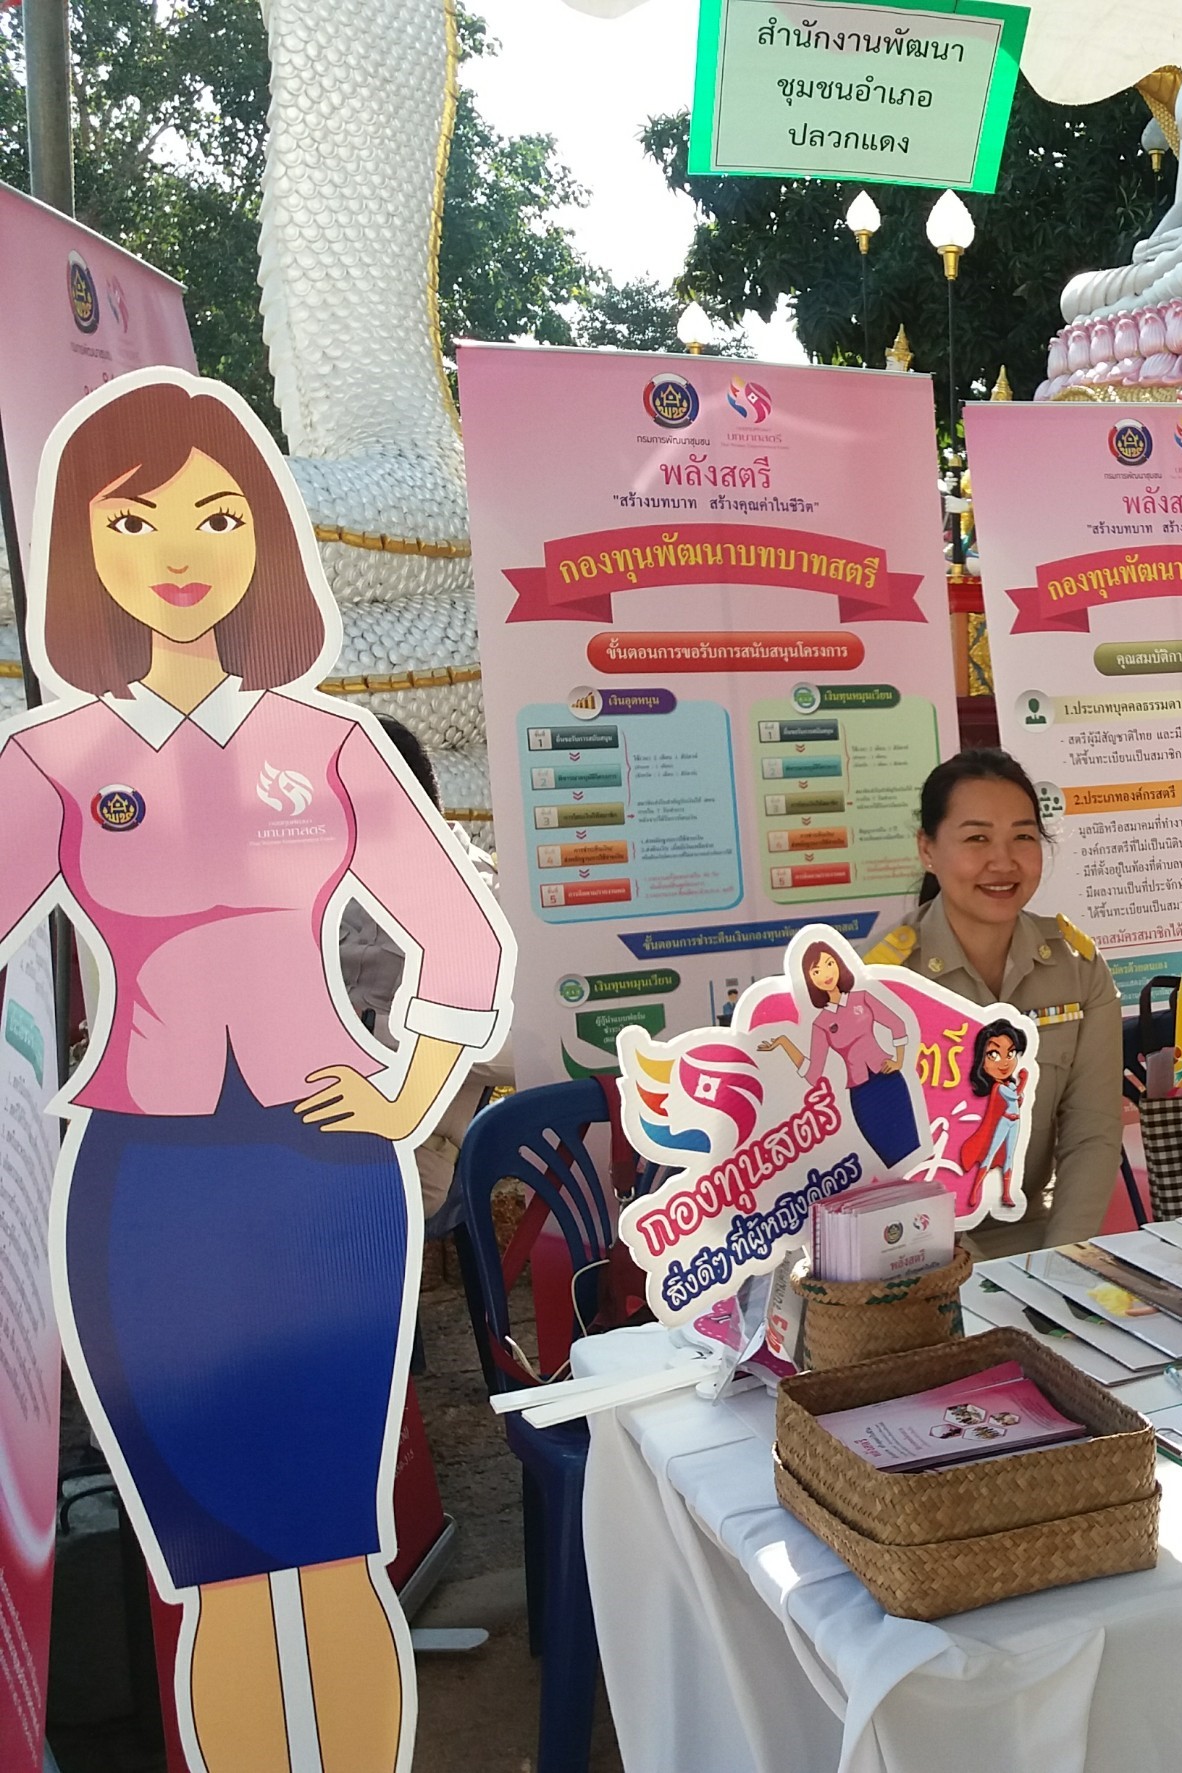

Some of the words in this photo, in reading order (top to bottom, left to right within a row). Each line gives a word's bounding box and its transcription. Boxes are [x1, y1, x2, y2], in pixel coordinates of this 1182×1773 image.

[757, 18, 965, 62] สำนักงานพัฒนา
[777, 75, 933, 108] ชุมชนอำเภอ
[788, 123, 910, 153] ปลวกแดง
[636, 434, 711, 448] กรมการพัฒนาชุมชน
[659, 453, 772, 490] พลังสตรี
[558, 531, 881, 590] กองทุนพัฒนาบทบาทสตรี
[605, 637, 849, 663] ขั้นตอนการขอรับการสนับสนุนโครงการ
[608, 694, 660, 709] เงินอุดหนุน
[1064, 699, 1182, 716] 1.ประเภทบุคคลธรรมดา
[1068, 727, 1153, 746] สตรีผู้มีสัญชาติไทย
[1073, 785, 1176, 806] 2.ประเภทองค์กรสตรี
[257, 824, 327, 839] บทบาทสตรี
[916, 1022, 969, 1090] ตรี
[637, 1077, 842, 1256] กองทุนสตรี
[664, 1250, 730, 1310] สิ่งดีๆ
